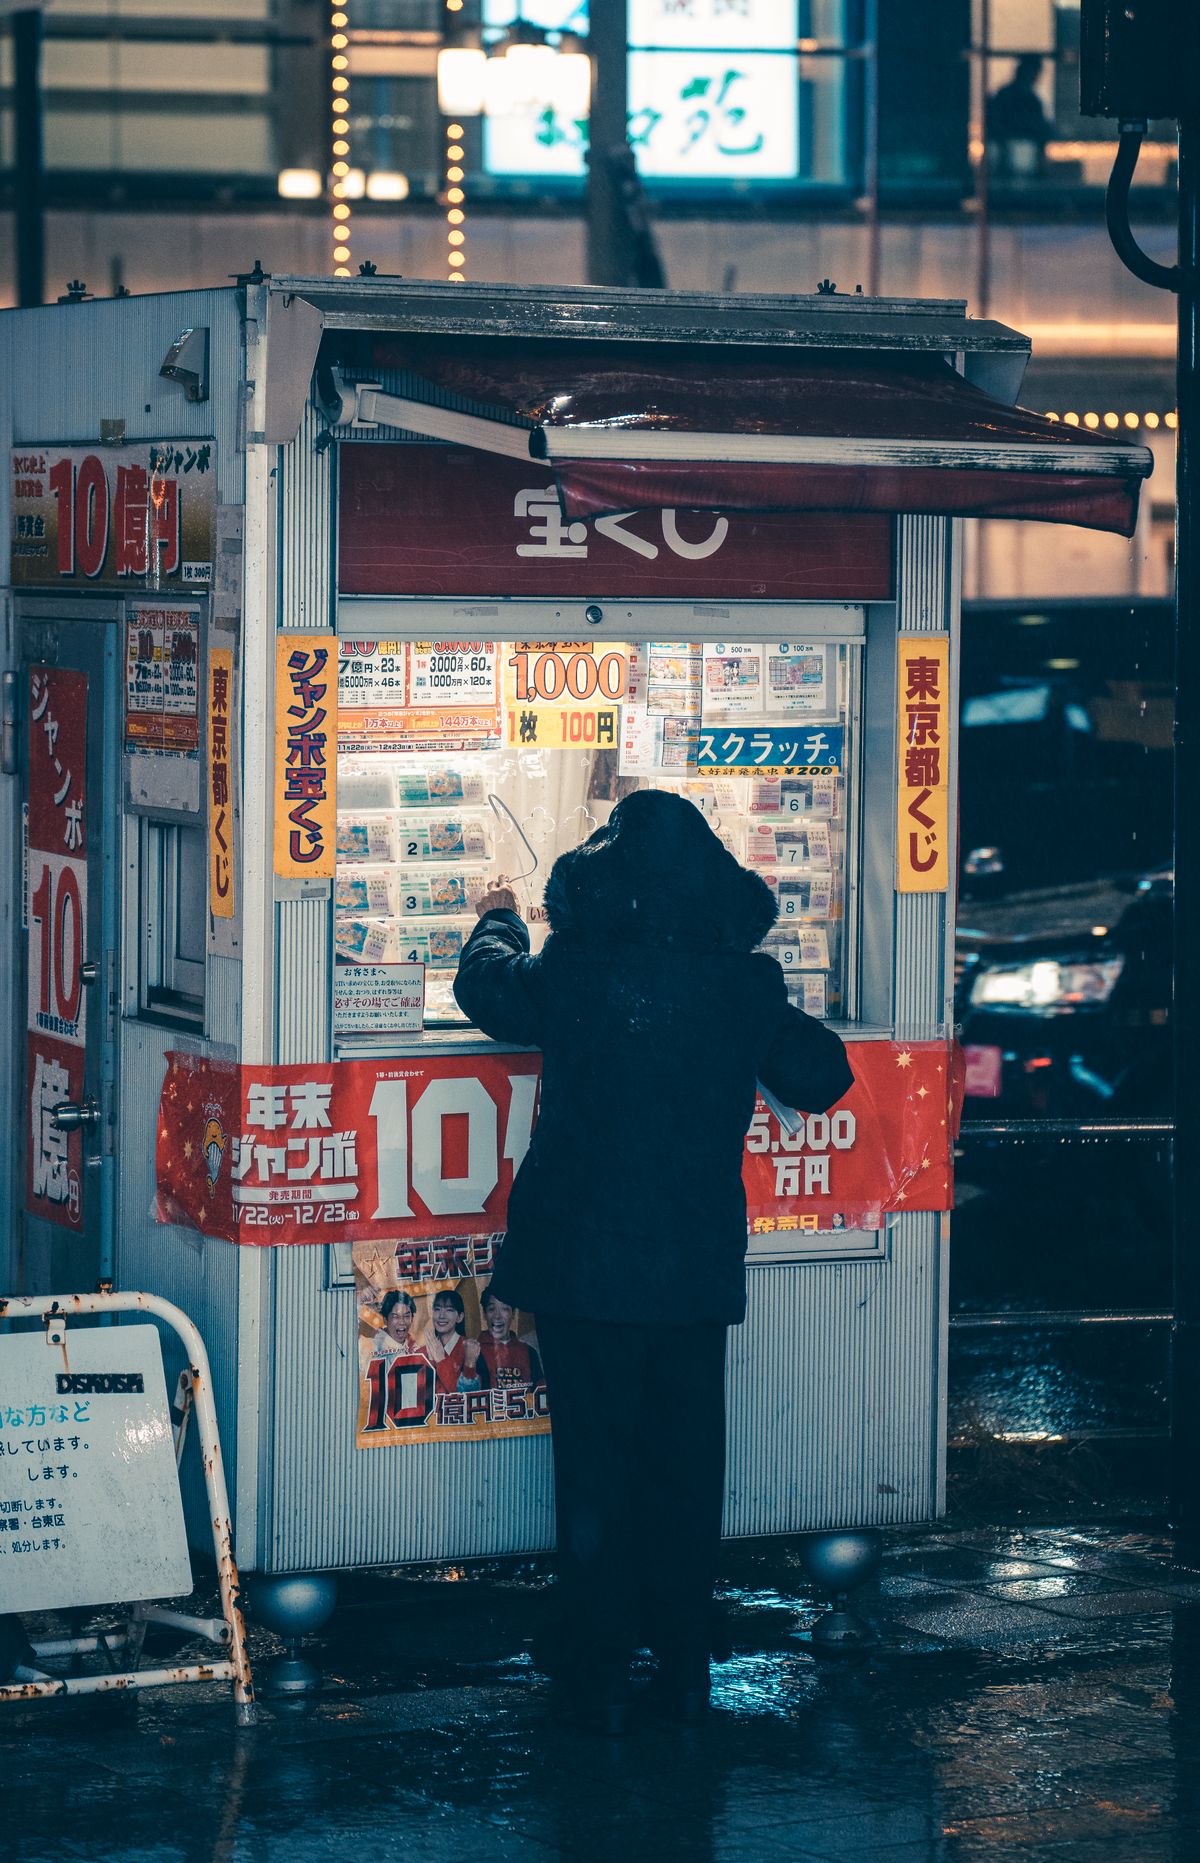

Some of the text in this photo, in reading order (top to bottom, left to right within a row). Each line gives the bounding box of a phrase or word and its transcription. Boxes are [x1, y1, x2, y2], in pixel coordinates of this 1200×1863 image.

[508, 710, 614, 743] 1枚 100円
[284, 648, 327, 864] ジャンボ宝くじ
[698, 732, 837, 766] スクラッチ。
[784, 766, 834, 775] ¥200
[905, 656, 940, 873] 東京都くじ
[212, 667, 230, 898] 東京都くじ
[789, 799, 799, 812] 6
[407, 842, 418, 856] 2
[788, 850, 797, 863] 7
[406, 896, 417, 910] 3
[785, 901, 795, 914] 8
[33, 864, 83, 1021] 10
[408, 950, 418, 963] 4
[784, 951, 793, 964] 9
[344, 968, 387, 977] お客さまへ
[335, 997, 421, 1009] 必ずその場でご確認
[246, 1081, 333, 1130] 年末
[231, 1130, 359, 1182] ジャンボ
[771, 1155, 831, 1197] 万円
[268, 1189, 313, 1201] 発売期間
[361, 1353, 437, 1433] 10
[434, 1389, 494, 1426] 億円
[28, 1464, 79, 1482] します。
[0, 1497, 64, 1513] 切断します。
[11, 1537, 67, 1554] 処分します。
